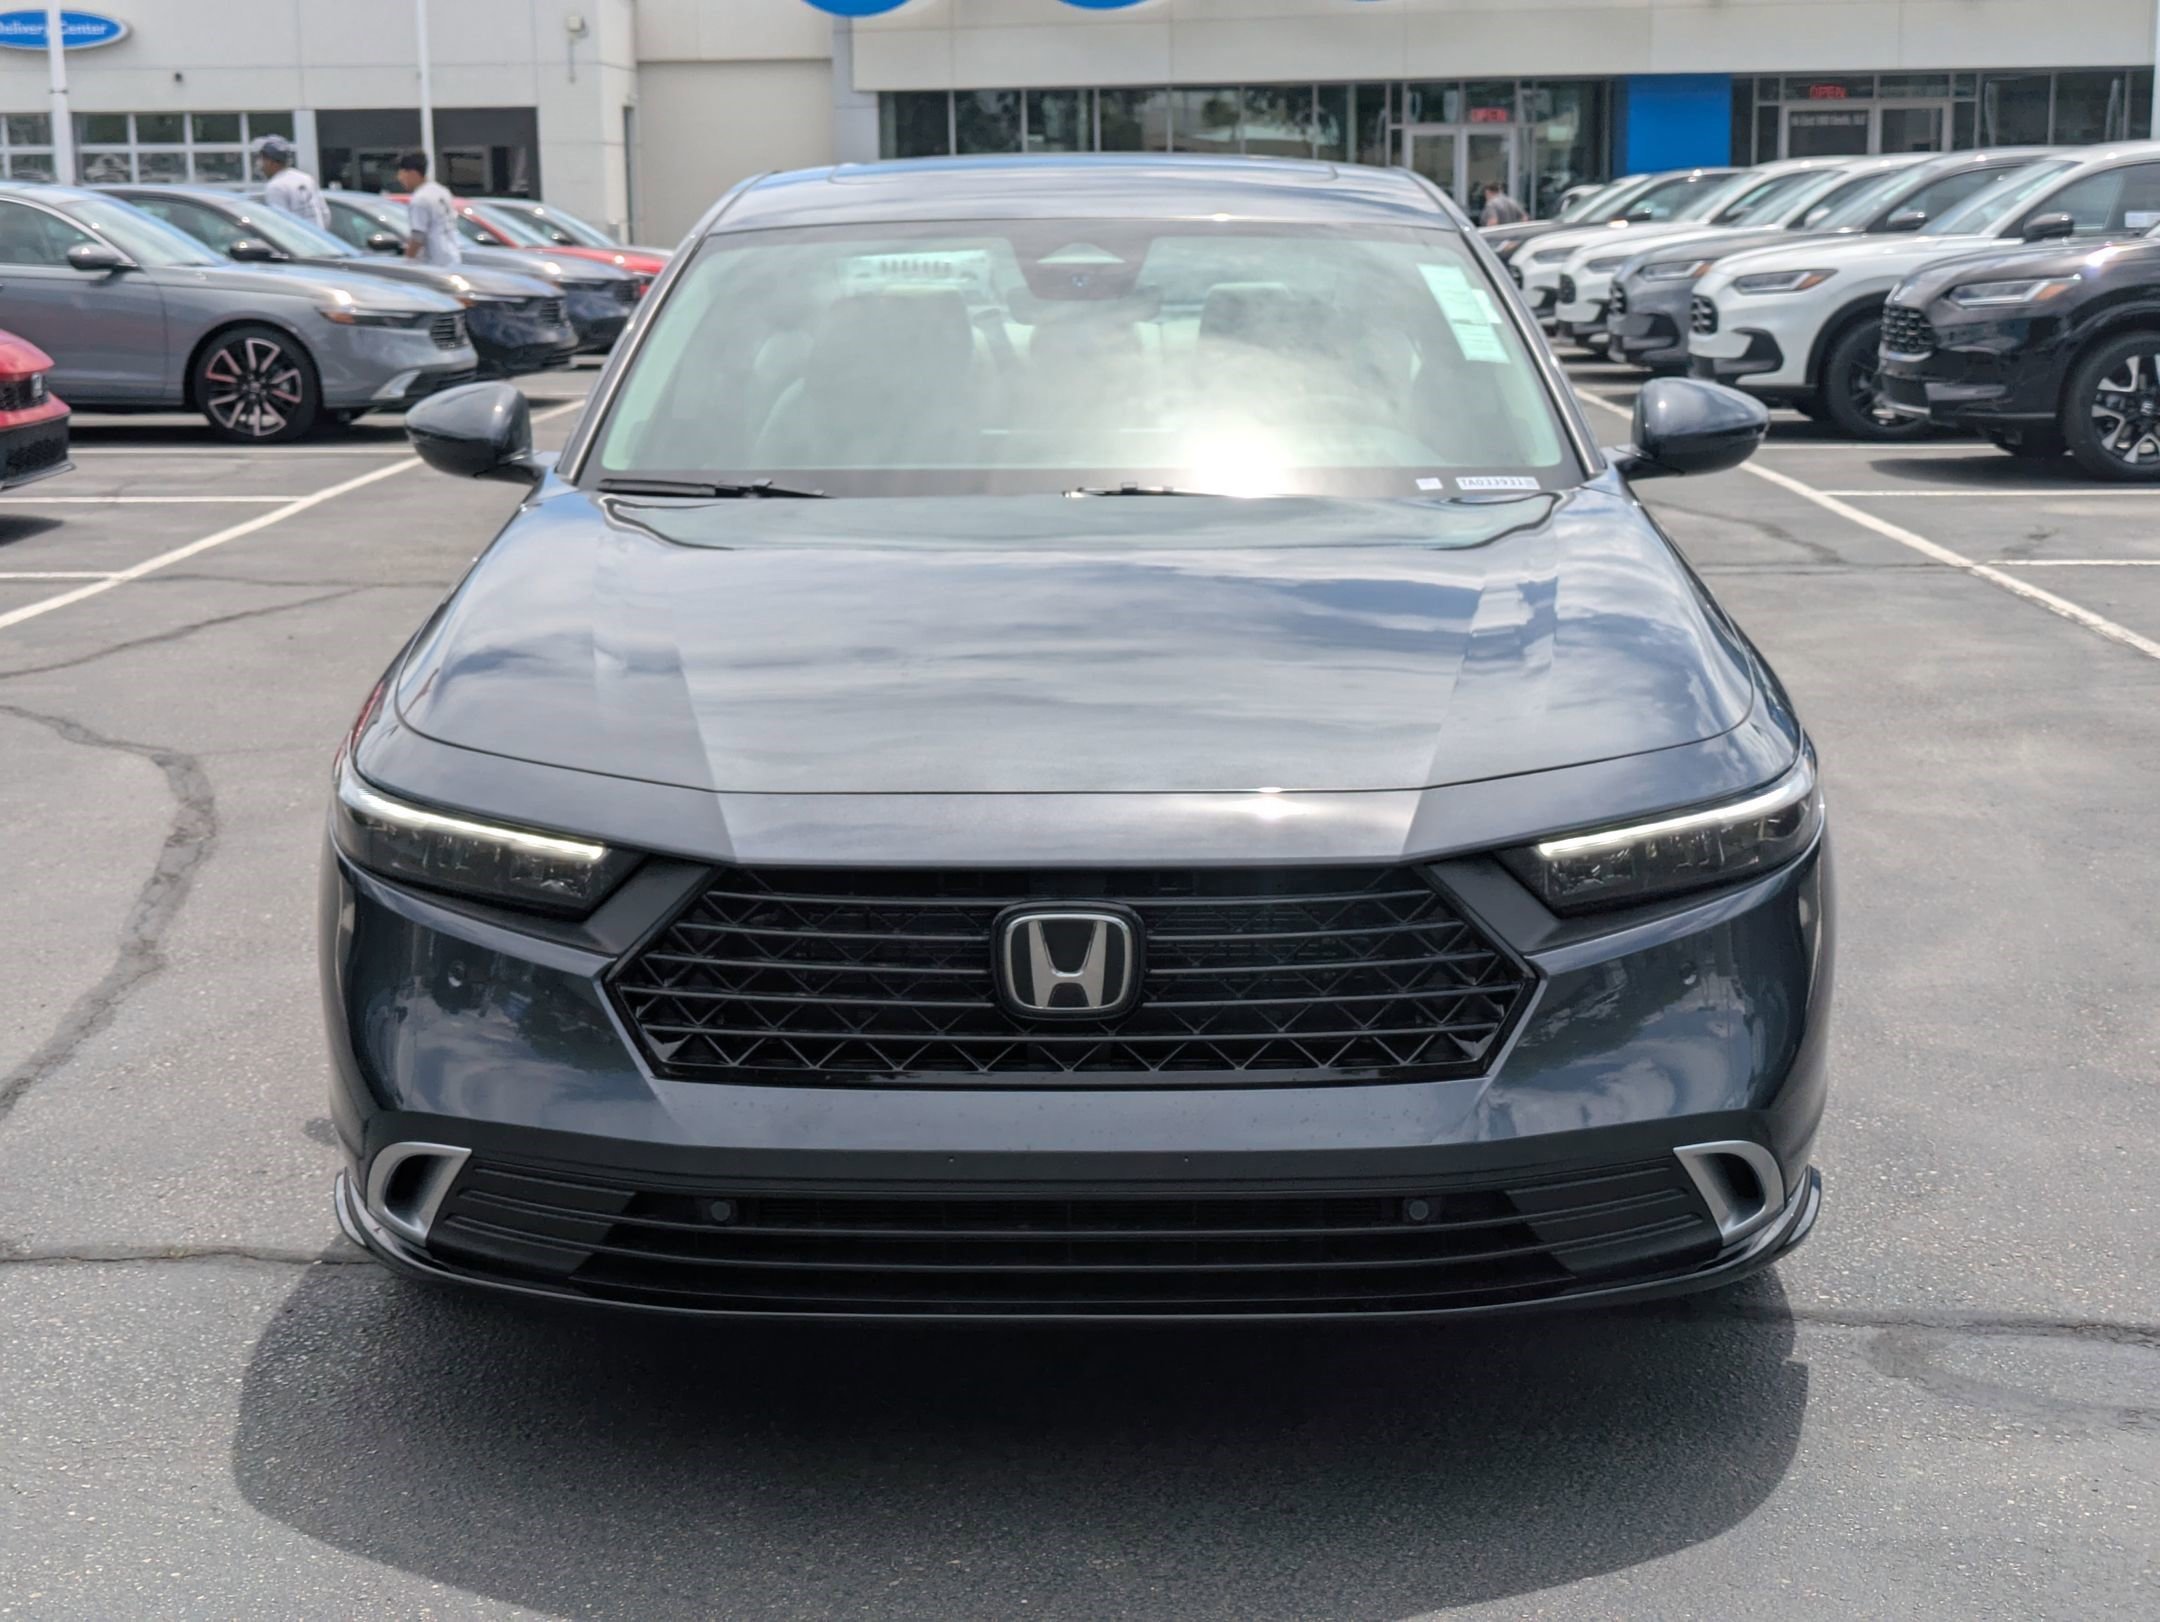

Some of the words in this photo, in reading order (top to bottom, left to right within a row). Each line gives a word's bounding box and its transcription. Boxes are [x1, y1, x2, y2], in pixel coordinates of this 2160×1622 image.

[0, 21, 48, 36] eliver
[1810, 84, 1846, 98] OPEN
[1471, 108, 1507, 122] OPEN
